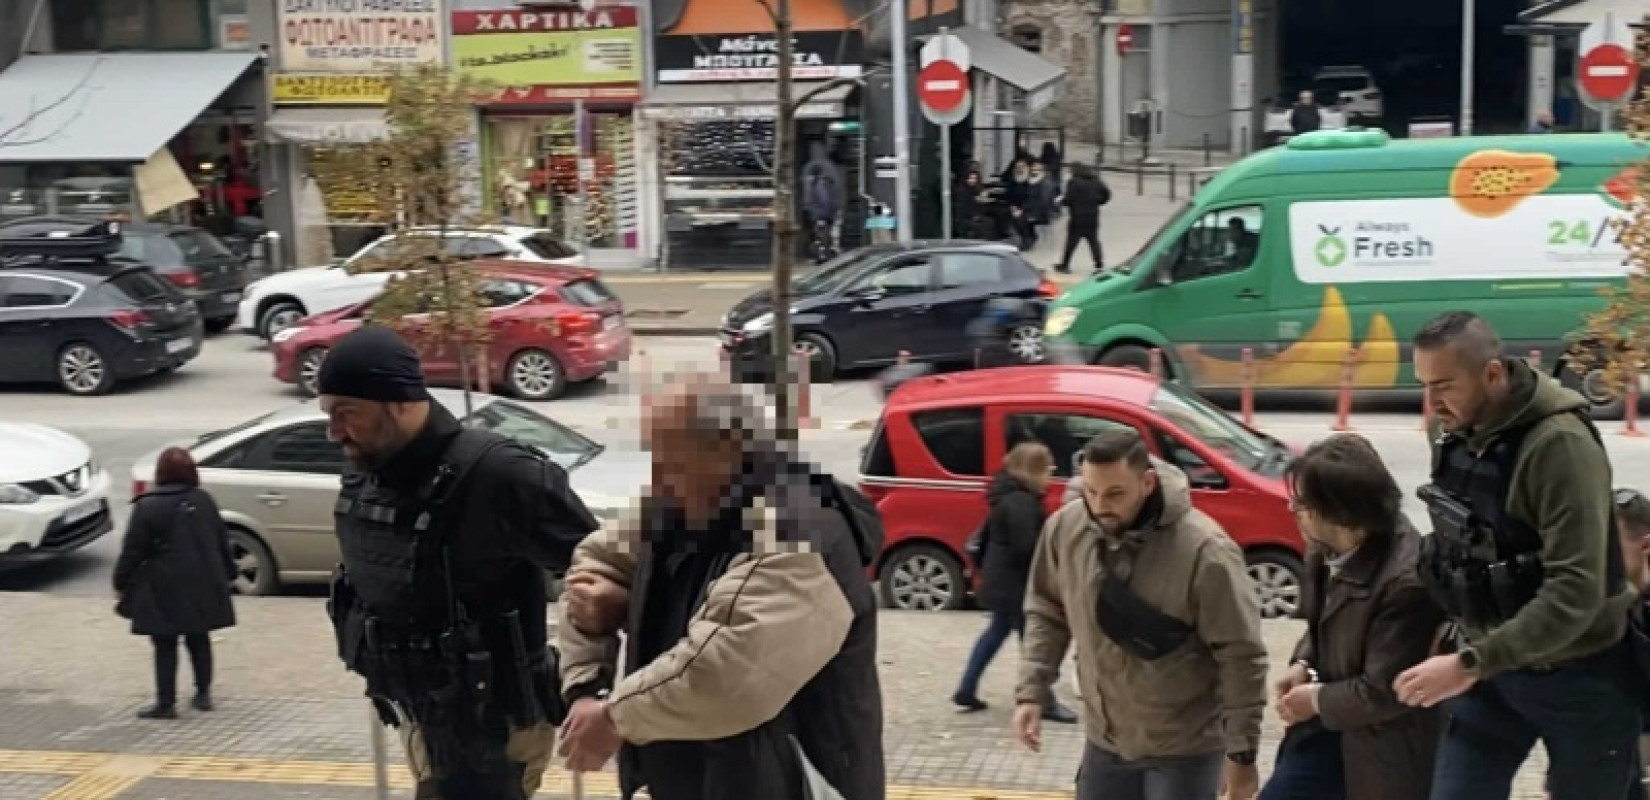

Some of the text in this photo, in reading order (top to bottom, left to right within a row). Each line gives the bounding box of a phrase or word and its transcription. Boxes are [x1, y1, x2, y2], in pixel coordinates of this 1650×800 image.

[475, 12, 614, 30] ΧΑΡΤΙΚΑ
[693, 53, 824, 69] ΜΠΟΥΓΑΣΑ
[1353, 235, 1434, 258] Fresh
